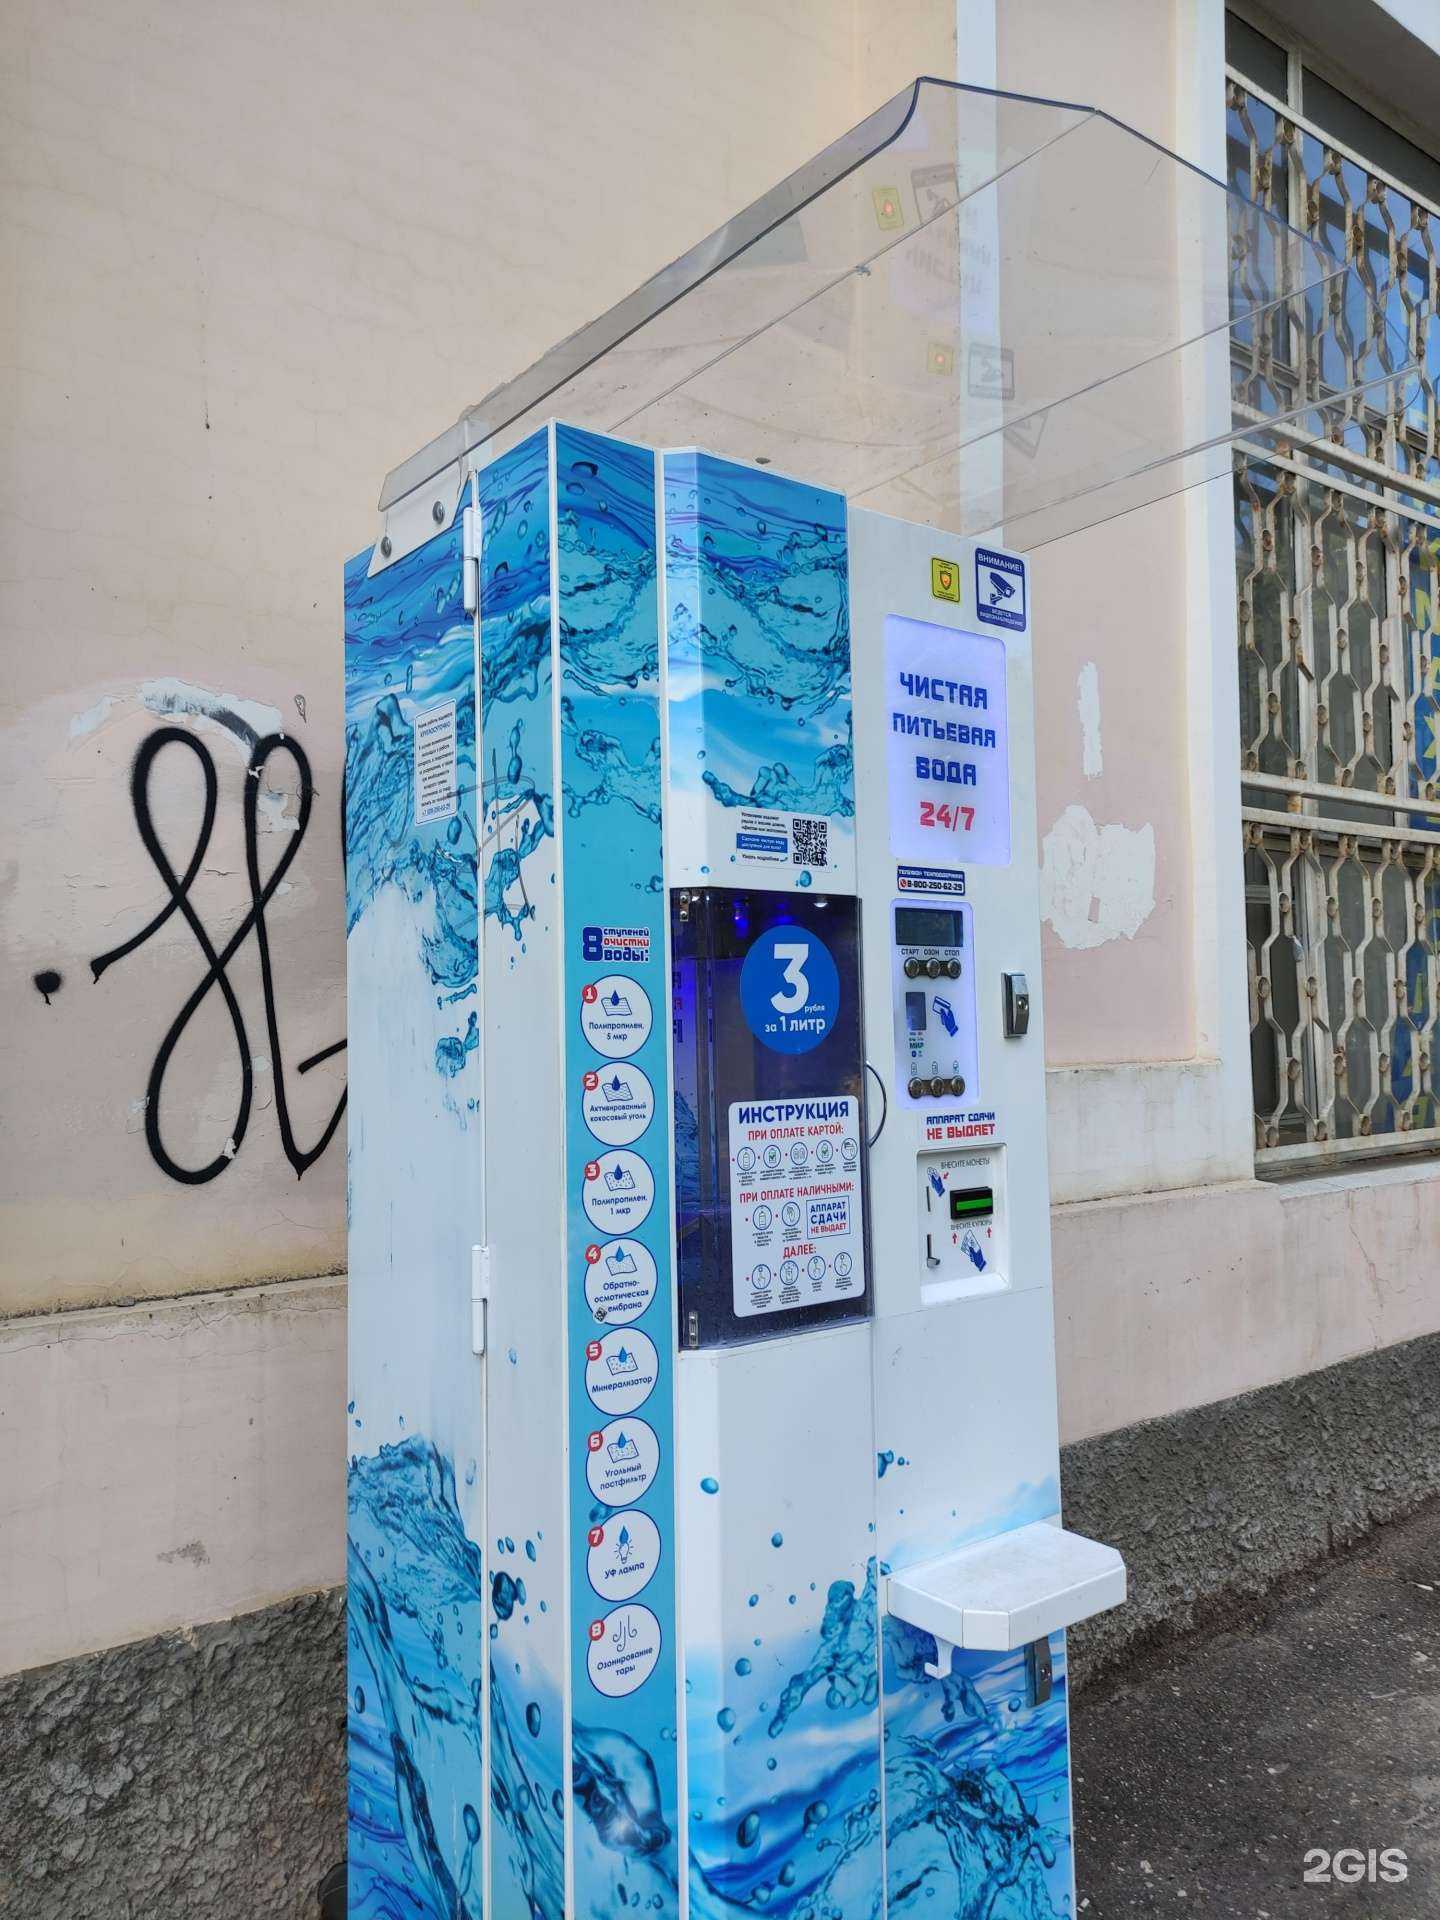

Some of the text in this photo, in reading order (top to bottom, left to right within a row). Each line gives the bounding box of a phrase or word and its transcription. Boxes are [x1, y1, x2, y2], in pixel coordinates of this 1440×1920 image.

[978, 553, 1022, 572] ВНИМАНИЕ!
[900, 671, 988, 710] ЧИСТАЯ
[893, 712, 996, 748] ПИТЬЕВАЯ
[916, 756, 977, 786] ВОДА
[919, 801, 976, 832] 24/7
[603, 928, 649, 938] ступеней
[583, 926, 603, 961] 8
[603, 938, 649, 946] очистки
[603, 946, 649, 961] воды:
[901, 948, 919, 956] СТАРТ
[770, 943, 809, 1014] 3
[585, 987, 594, 1000] 1
[804, 1004, 825, 1014] рубля
[765, 1016, 826, 1034] за 1 литр
[606, 1033, 611, 1041] 5
[586, 1074, 596, 1087] 2
[590, 1102, 646, 1112] Активированный
[739, 1101, 849, 1124] ИНСТРУКЦИЯ
[590, 1112, 646, 1122] кокосовый уголь
[926, 1112, 995, 1125] АППАРАТ СДАЧИ
[748, 1122, 844, 1141] ПРИ ОПЛАТЕ КАРТОЙ:
[927, 1123, 995, 1140] НЕ ВЫДАЕТ
[587, 1163, 597, 1177] 3
[740, 1182, 854, 1203] ПРИ ОПЛАТЕ НАЛИЧНЫМИ:
[615, 1207, 631, 1215] мкр
[810, 1201, 846, 1213] АППАРАТ
[810, 1212, 846, 1224] СДАЧИ
[811, 1223, 846, 1234] НЕ ВЫДАЕТ
[588, 1246, 597, 1260] 4
[783, 1243, 817, 1259] ДАЛЕЕ:
[603, 1280, 640, 1291] Обратно-
[594, 1290, 649, 1303] осмотическая
[605, 1301, 642, 1313] ембрана
[589, 1343, 599, 1357] 5
[592, 1376, 652, 1393] Минерализатор
[590, 1433, 600, 1448] 6
[605, 1463, 642, 1478] Угольный
[600, 1474, 647, 1490] постфильтр
[591, 1528, 600, 1543] 7
[604, 1562, 645, 1579] УФ лампа
[591, 1622, 601, 1637] 8
[597, 1647, 653, 1670] Озонирование
[615, 1665, 636, 1676] тары
